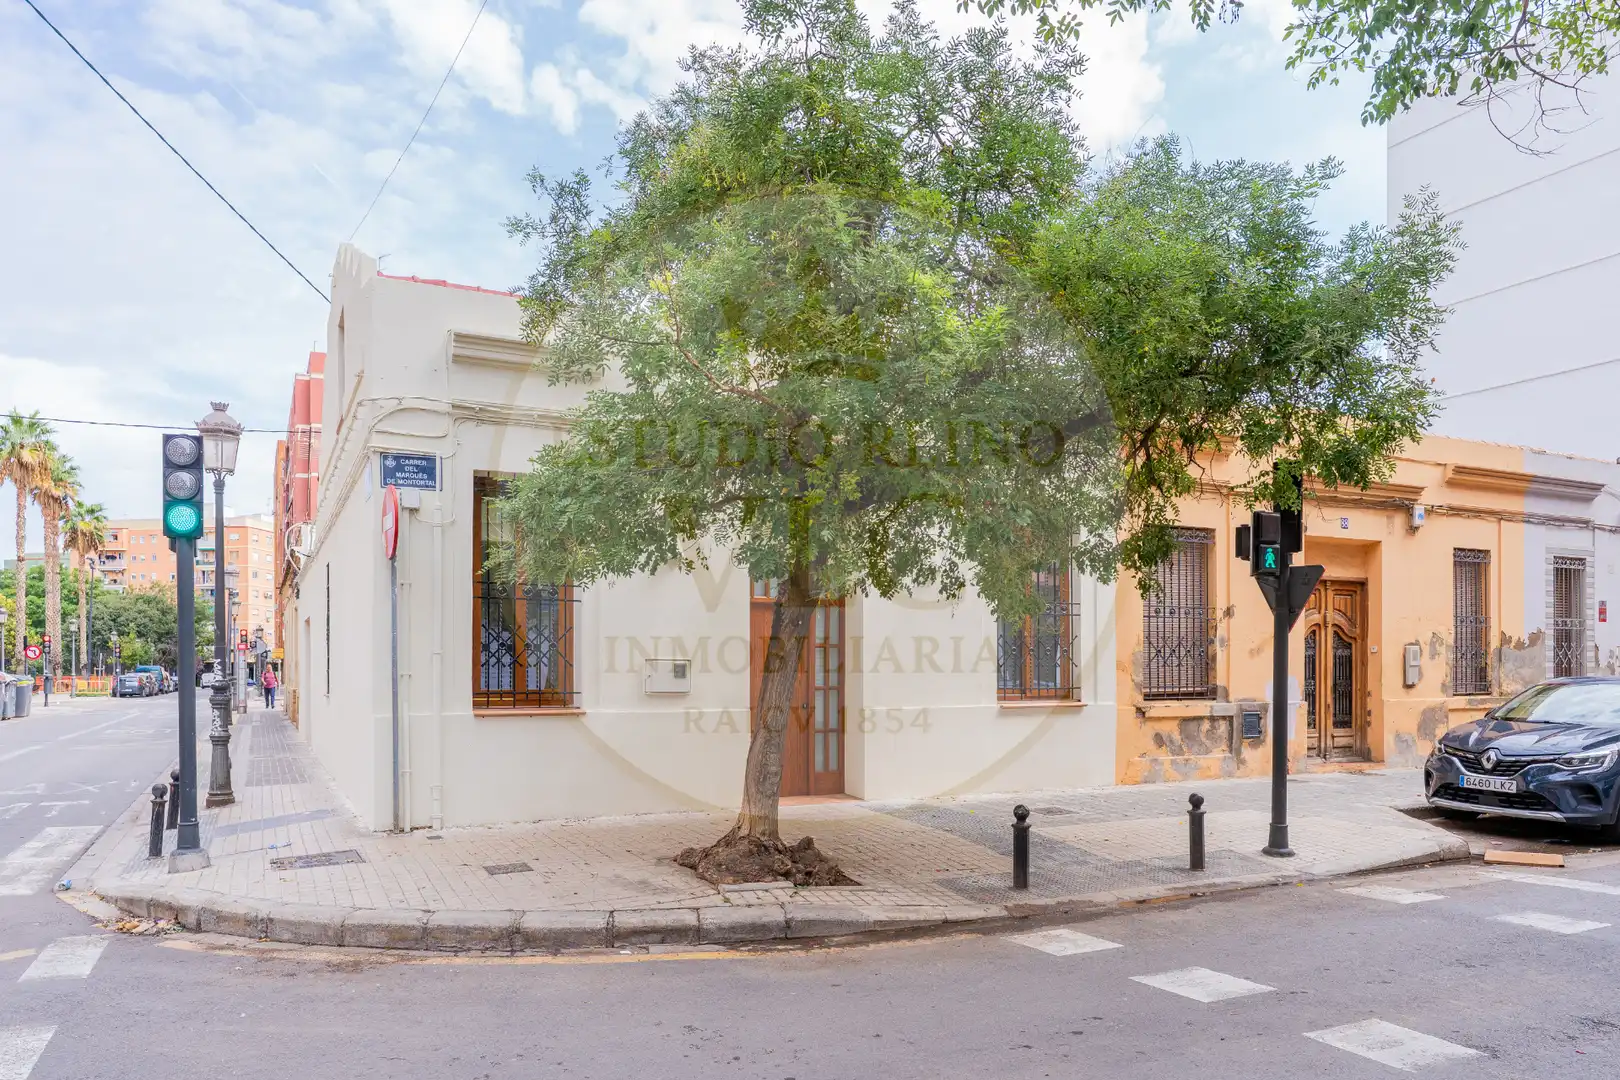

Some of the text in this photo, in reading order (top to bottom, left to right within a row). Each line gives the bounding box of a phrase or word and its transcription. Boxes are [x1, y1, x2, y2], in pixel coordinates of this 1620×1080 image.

[397, 478, 436, 486] MONTORTAL
[1465, 777, 1514, 792] 6460 LKZ
